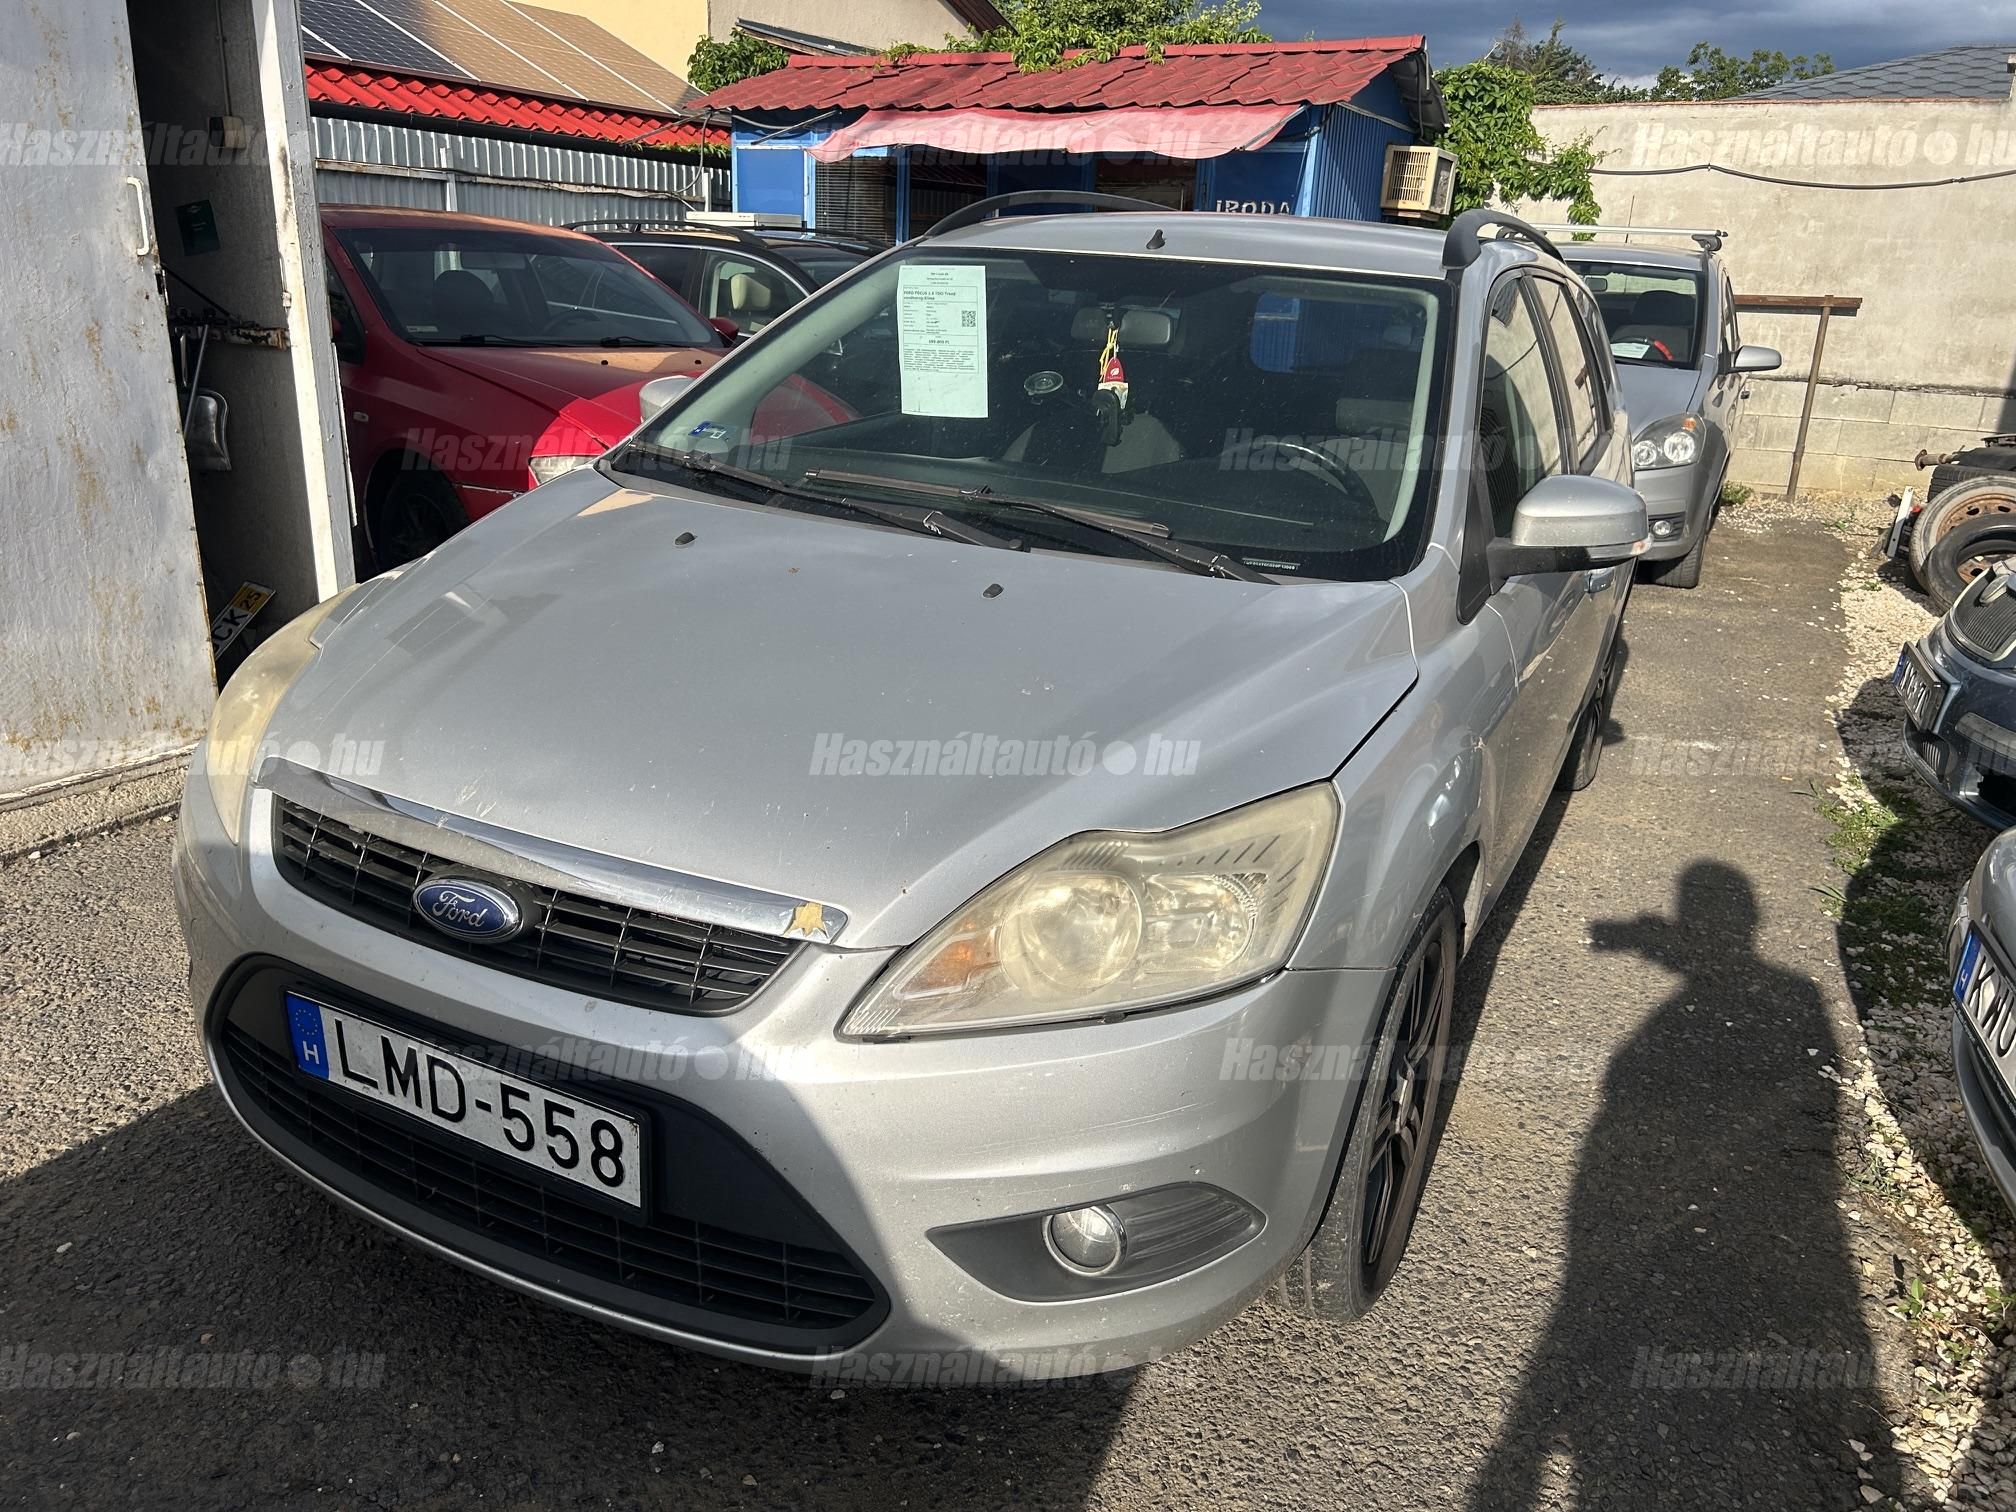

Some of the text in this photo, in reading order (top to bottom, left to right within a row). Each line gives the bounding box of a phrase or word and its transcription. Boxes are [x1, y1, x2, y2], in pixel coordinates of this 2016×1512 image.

[1216, 200, 1290, 214] IRODA
[211, 608, 249, 655] CK
[432, 890, 488, 927] Ford
[302, 1040, 320, 1066] H
[334, 1018, 625, 1188] LMD-558
